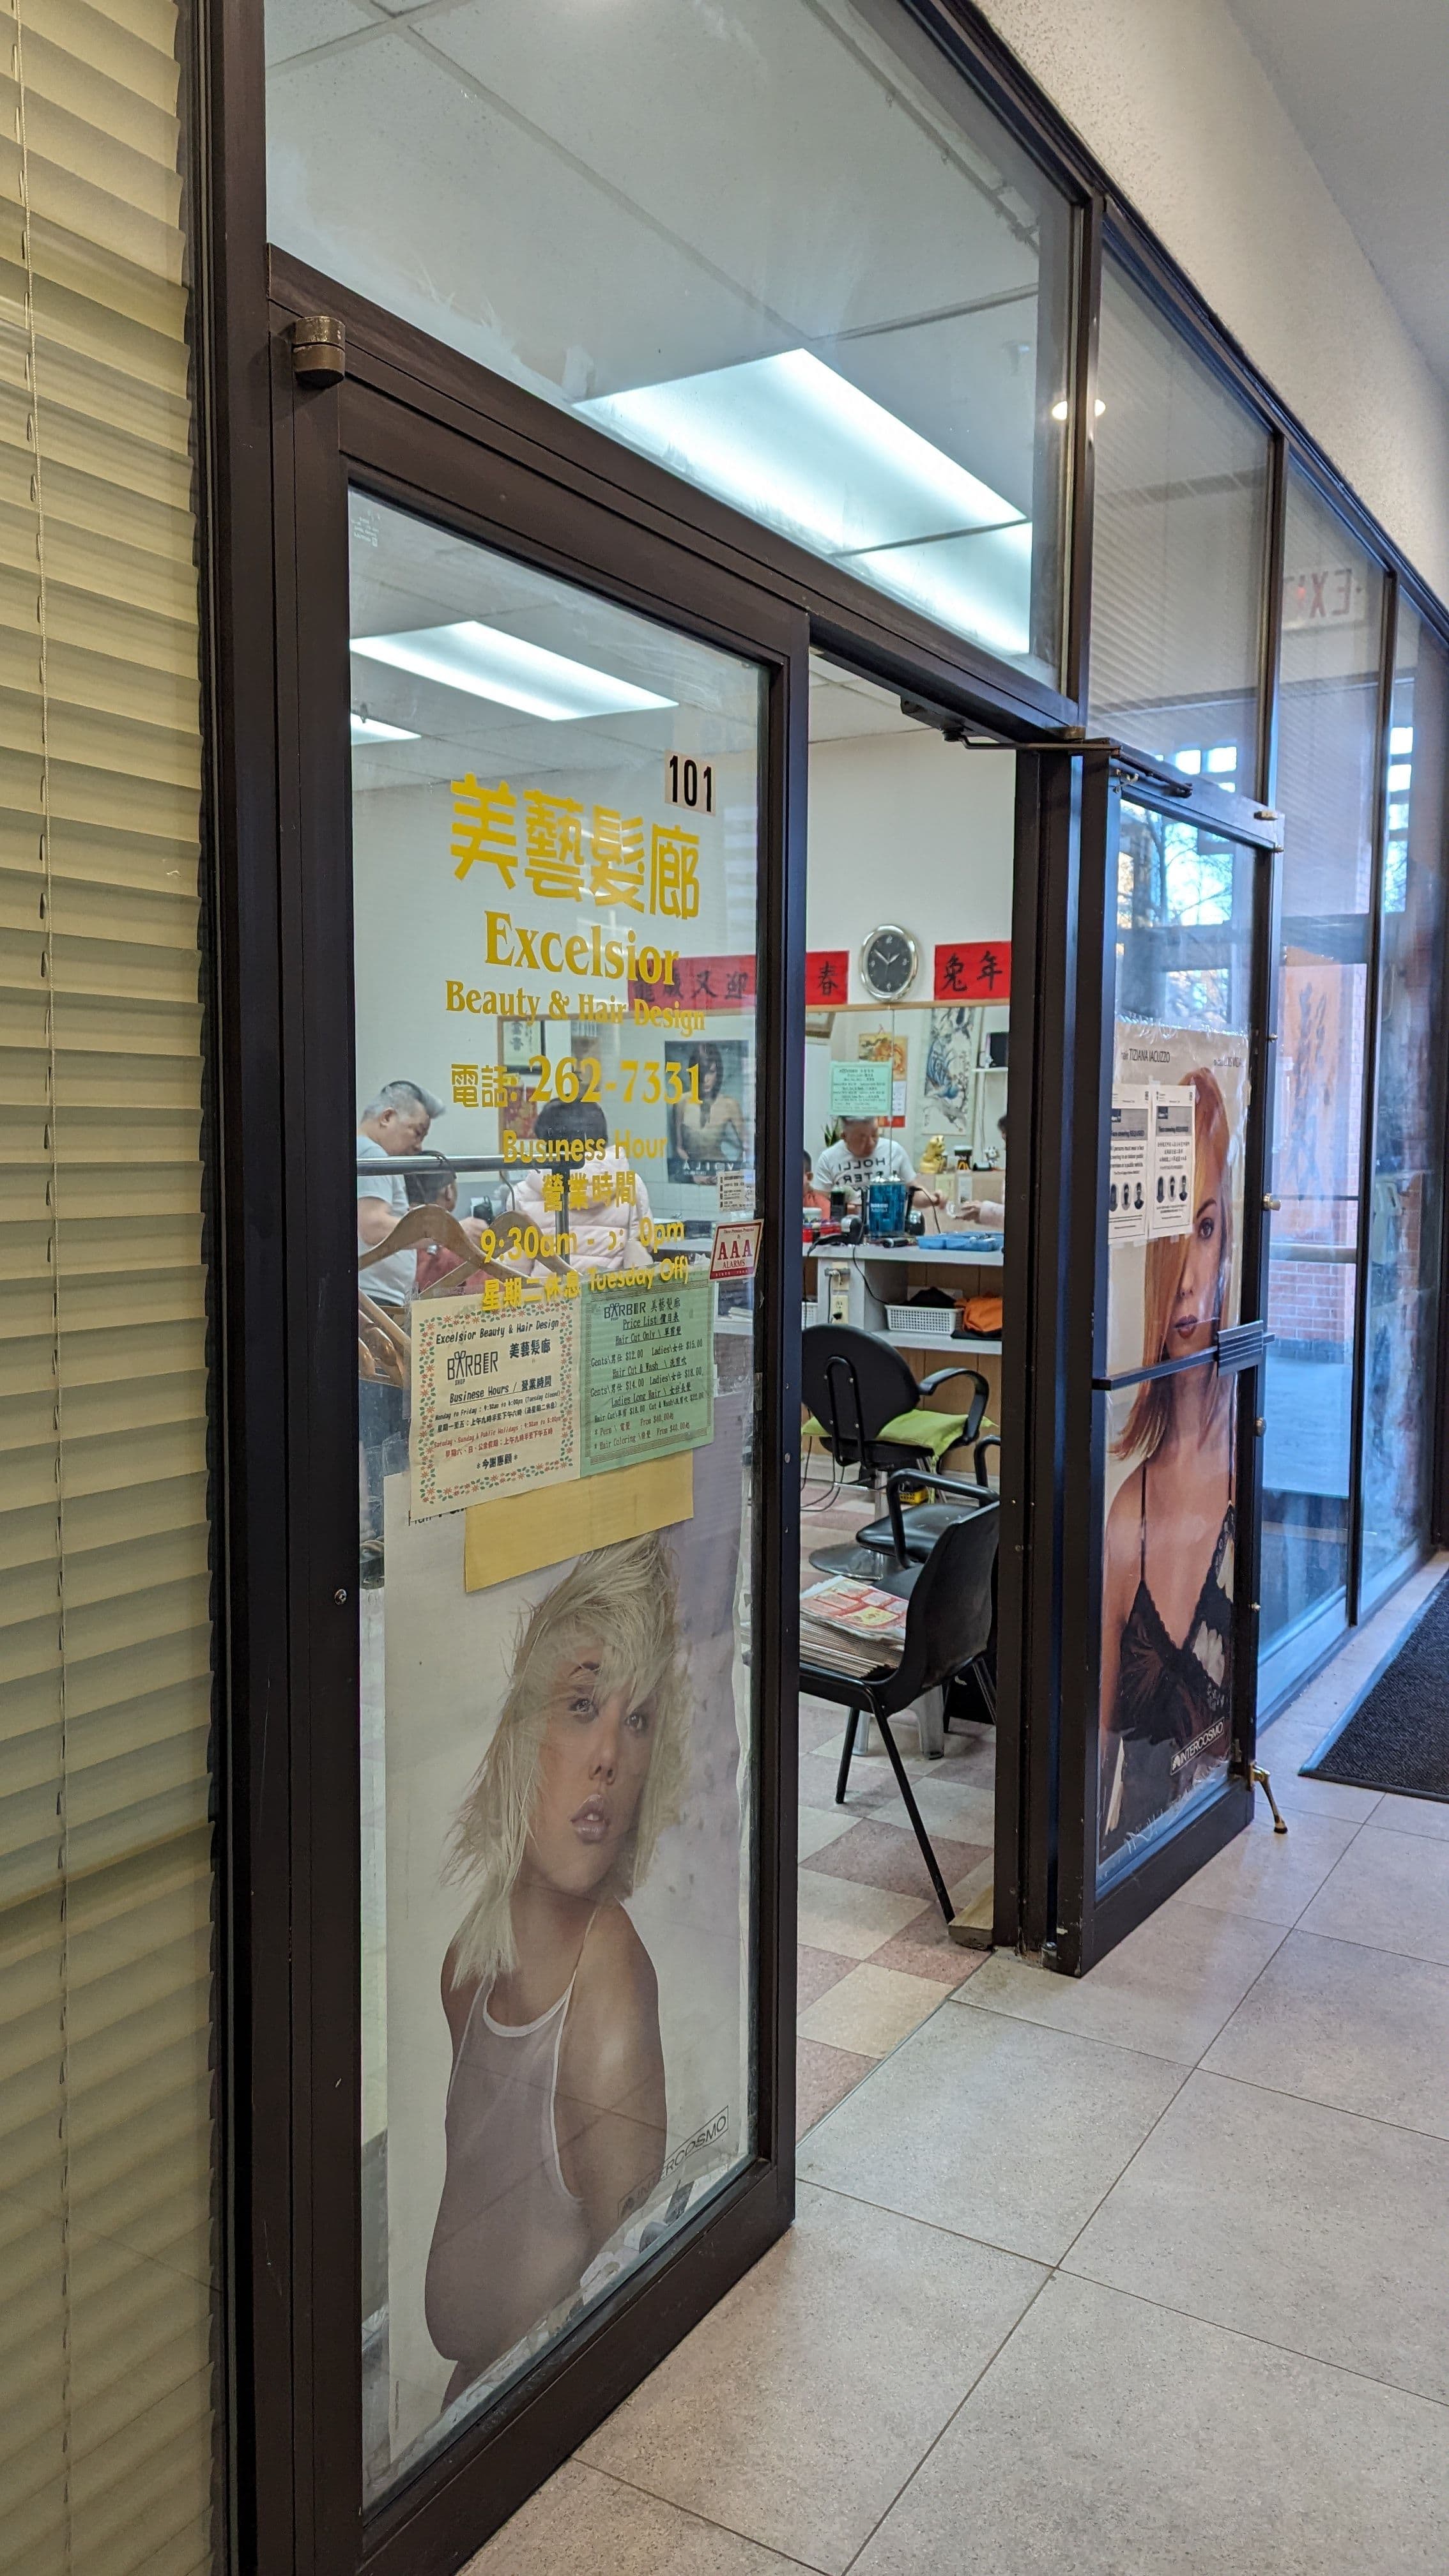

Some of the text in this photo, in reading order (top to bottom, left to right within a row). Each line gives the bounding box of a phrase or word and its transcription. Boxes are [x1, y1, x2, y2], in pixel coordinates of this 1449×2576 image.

[670, 755, 711, 813] 101
[450, 772, 700, 919] 美藝髮廊
[484, 910, 679, 985] Excelsior
[941, 950, 1002, 992] 兔年
[445, 980, 705, 1038] Beauty & Hair Design
[528, 1055, 703, 1104] 262-7331
[503, 1128, 668, 1163] Business Hour
[542, 1170, 636, 1213] 營業時間
[480, 1226, 578, 1263] 9:30am
[717, 1239, 753, 1260] AAA
[723, 1259, 746, 1268] ALARMS
[483, 1272, 580, 1310] 星期二休息
[436, 1319, 559, 1345] Excelsior Beauty & Hair Design
[623, 1319, 640, 1330] Price
[643, 1315, 657, 1326] List
[447, 1338, 551, 1380] BARBER 美藝髮廊
[646, 1362, 659, 1371] Wash
[488, 1384, 509, 1396] Hours
[521, 1376, 552, 1392] 營業時間
[611, 1396, 631, 1407] Ladies
[461, 1408, 477, 1418] Friday
[1181, 1721, 1223, 1765] INTERCOSMO
